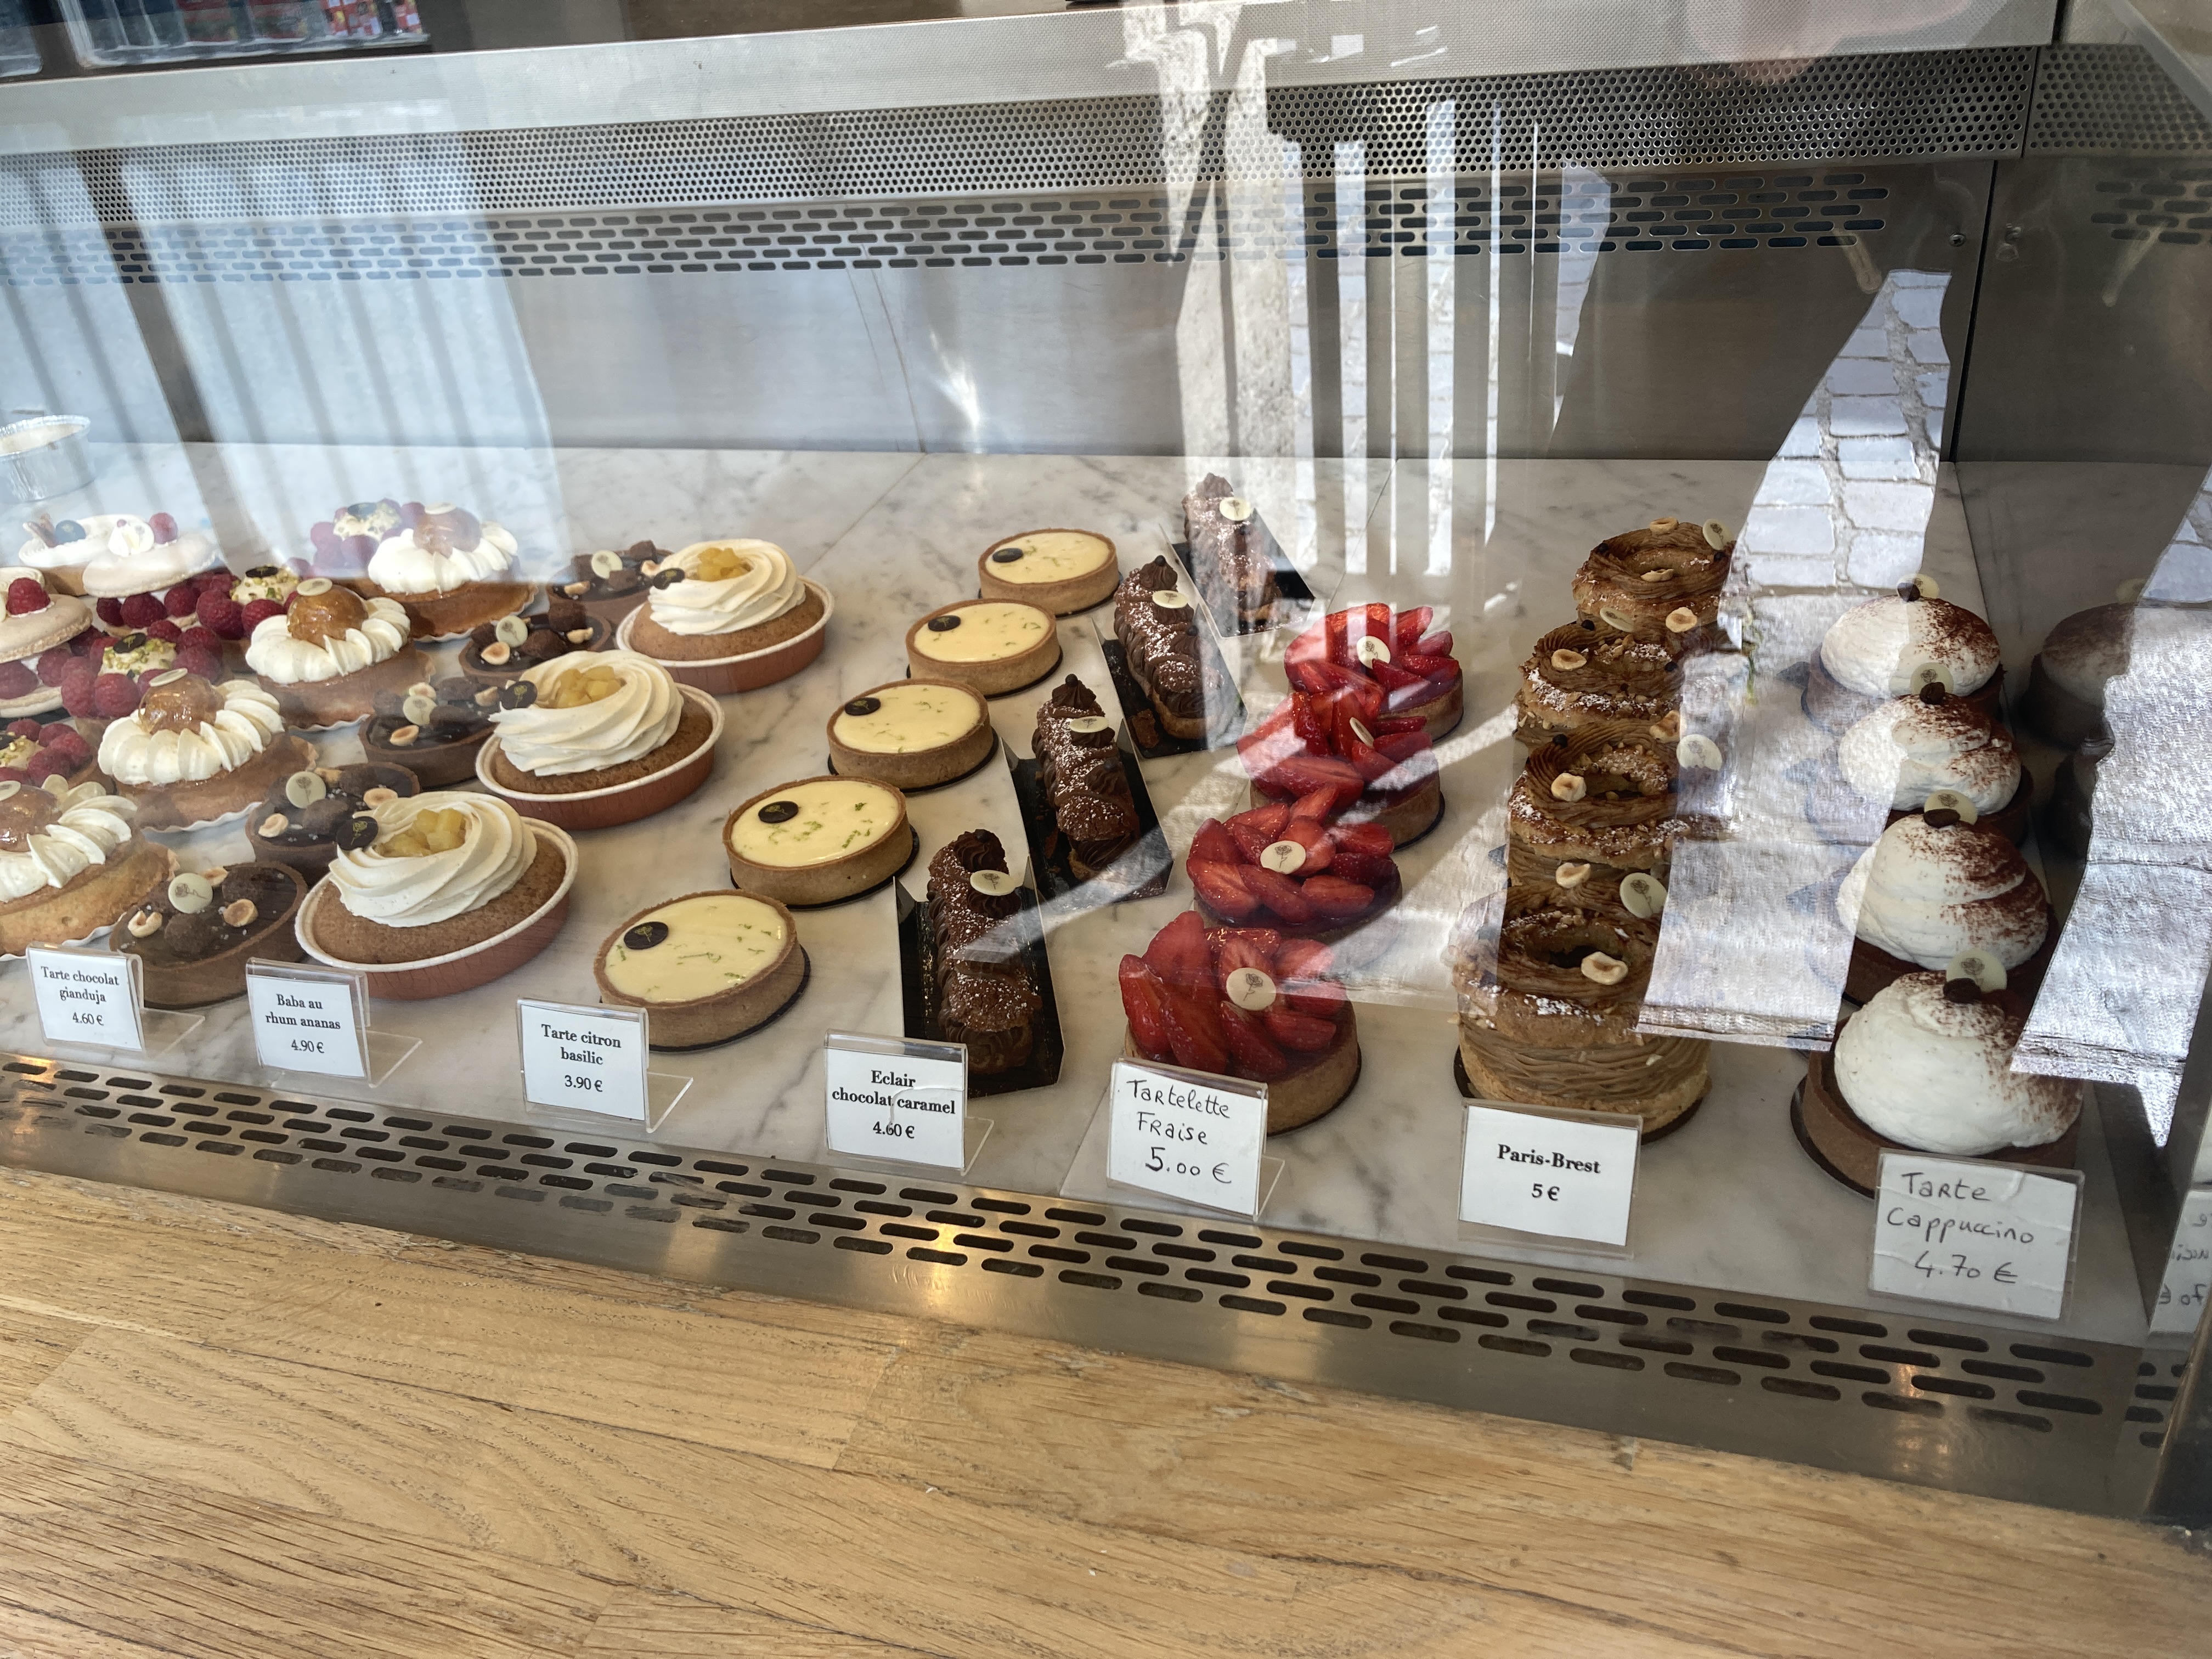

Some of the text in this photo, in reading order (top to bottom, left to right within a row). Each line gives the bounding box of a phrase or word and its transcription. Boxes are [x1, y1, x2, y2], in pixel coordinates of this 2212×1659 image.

[41, 967, 119, 985] Tarte chocolat
[60, 987, 105, 1005] gianduja
[276, 994, 306, 1007] Baba
[73, 1013, 103, 1025] 4.60 €
[266, 1012, 340, 1029] rhum ananas
[541, 1024, 621, 1048] Tarte citron
[291, 1040, 324, 1053] 4.90 €
[561, 1047, 604, 1065] basilic
[565, 1075, 602, 1092] 3.90 €
[871, 1070, 916, 1087] Eclair
[832, 1087, 955, 1114] chocolat caramel
[873, 1121, 914, 1138] 4.60 €
[1146, 1147, 1231, 1183] 5.00 €
[1498, 1144, 1600, 1173] Paris-Brest
[1532, 1184, 1559, 1200] 5 €
[1887, 1207, 2034, 1243] Cappuccino
[1915, 1251, 2017, 1283] 4.70 €
